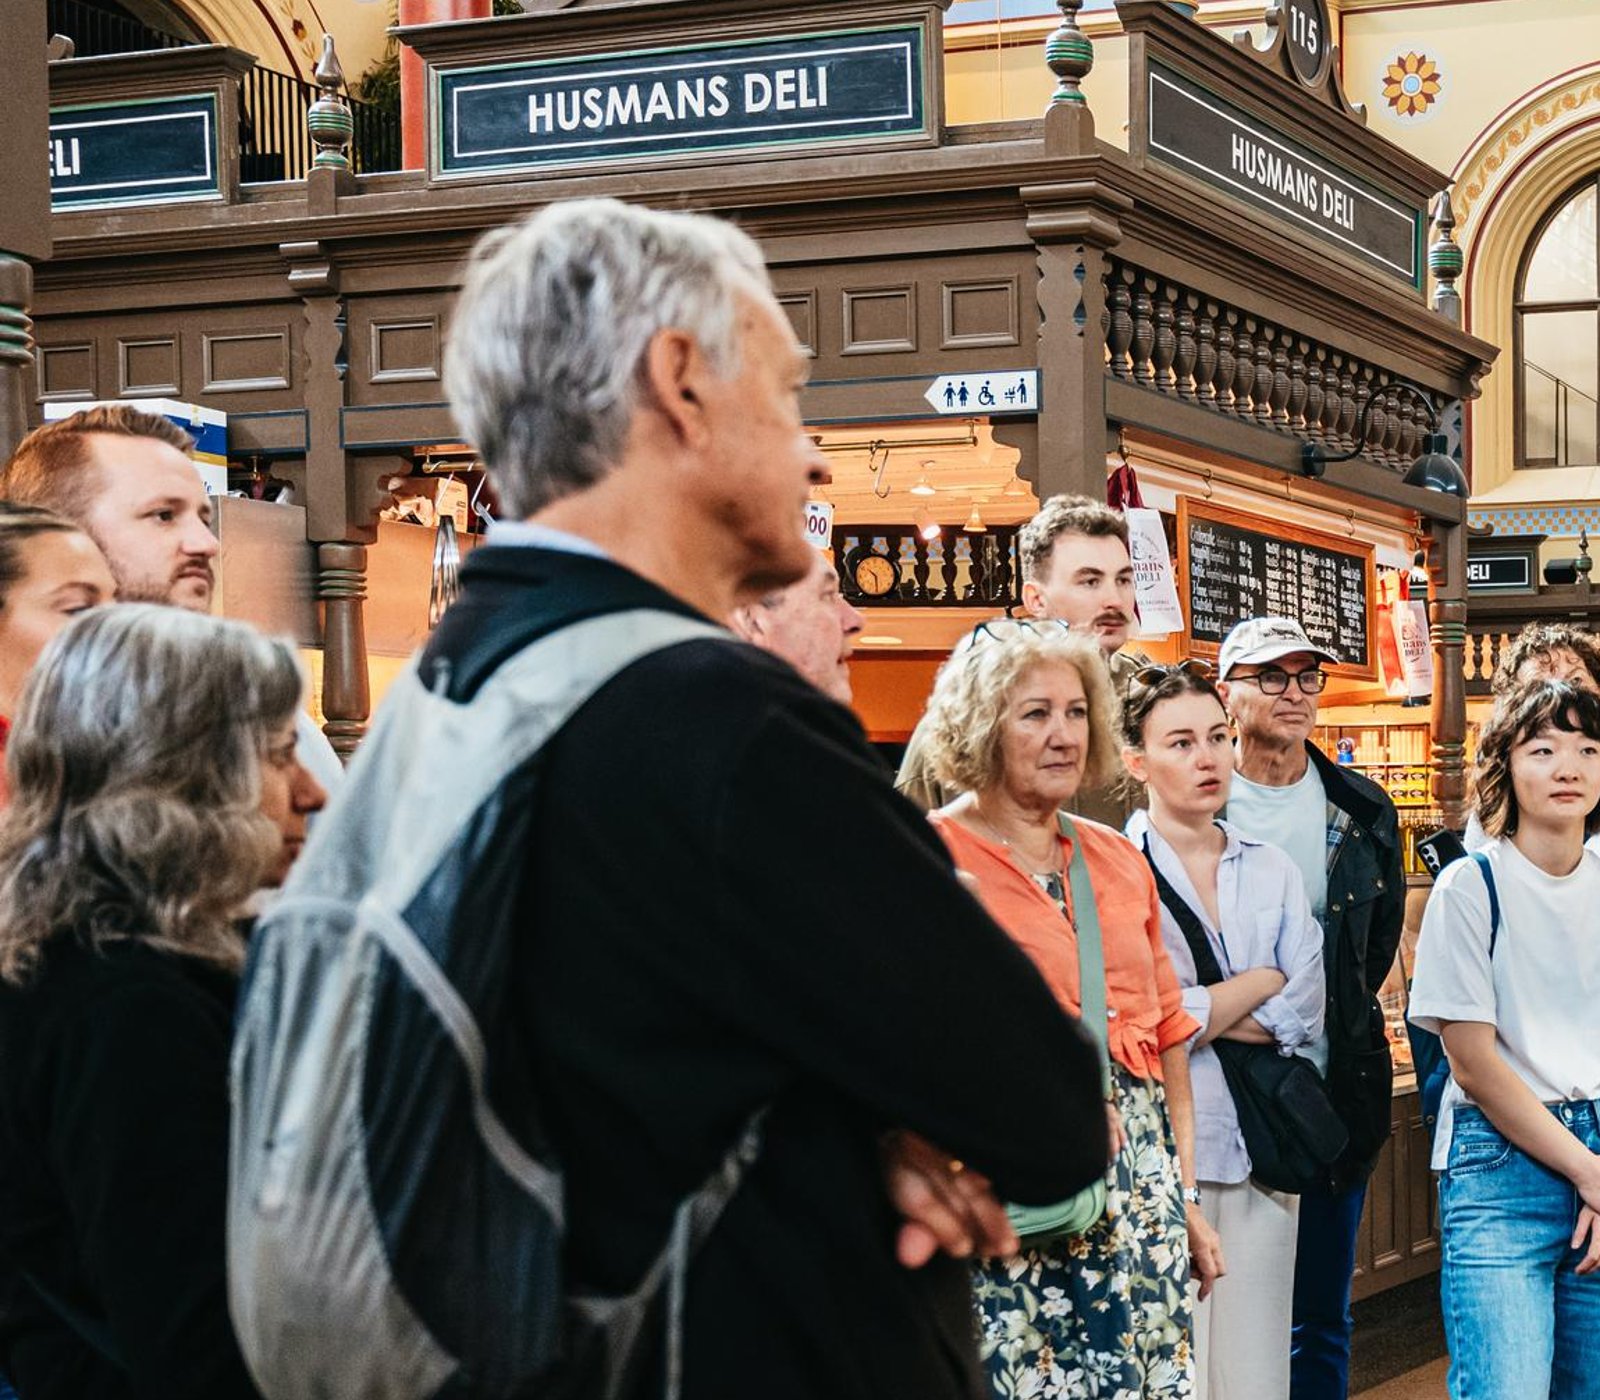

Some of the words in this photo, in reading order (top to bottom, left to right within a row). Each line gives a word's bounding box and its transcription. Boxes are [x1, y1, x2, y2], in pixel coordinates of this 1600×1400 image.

[1291, 4, 1317, 55] 115
[528, 75, 730, 134] HUSMANS
[744, 65, 828, 113] DELI
[1231, 133, 1318, 213] HUSMANS
[1322, 185, 1354, 231] DELI
[804, 514, 827, 535] 00
